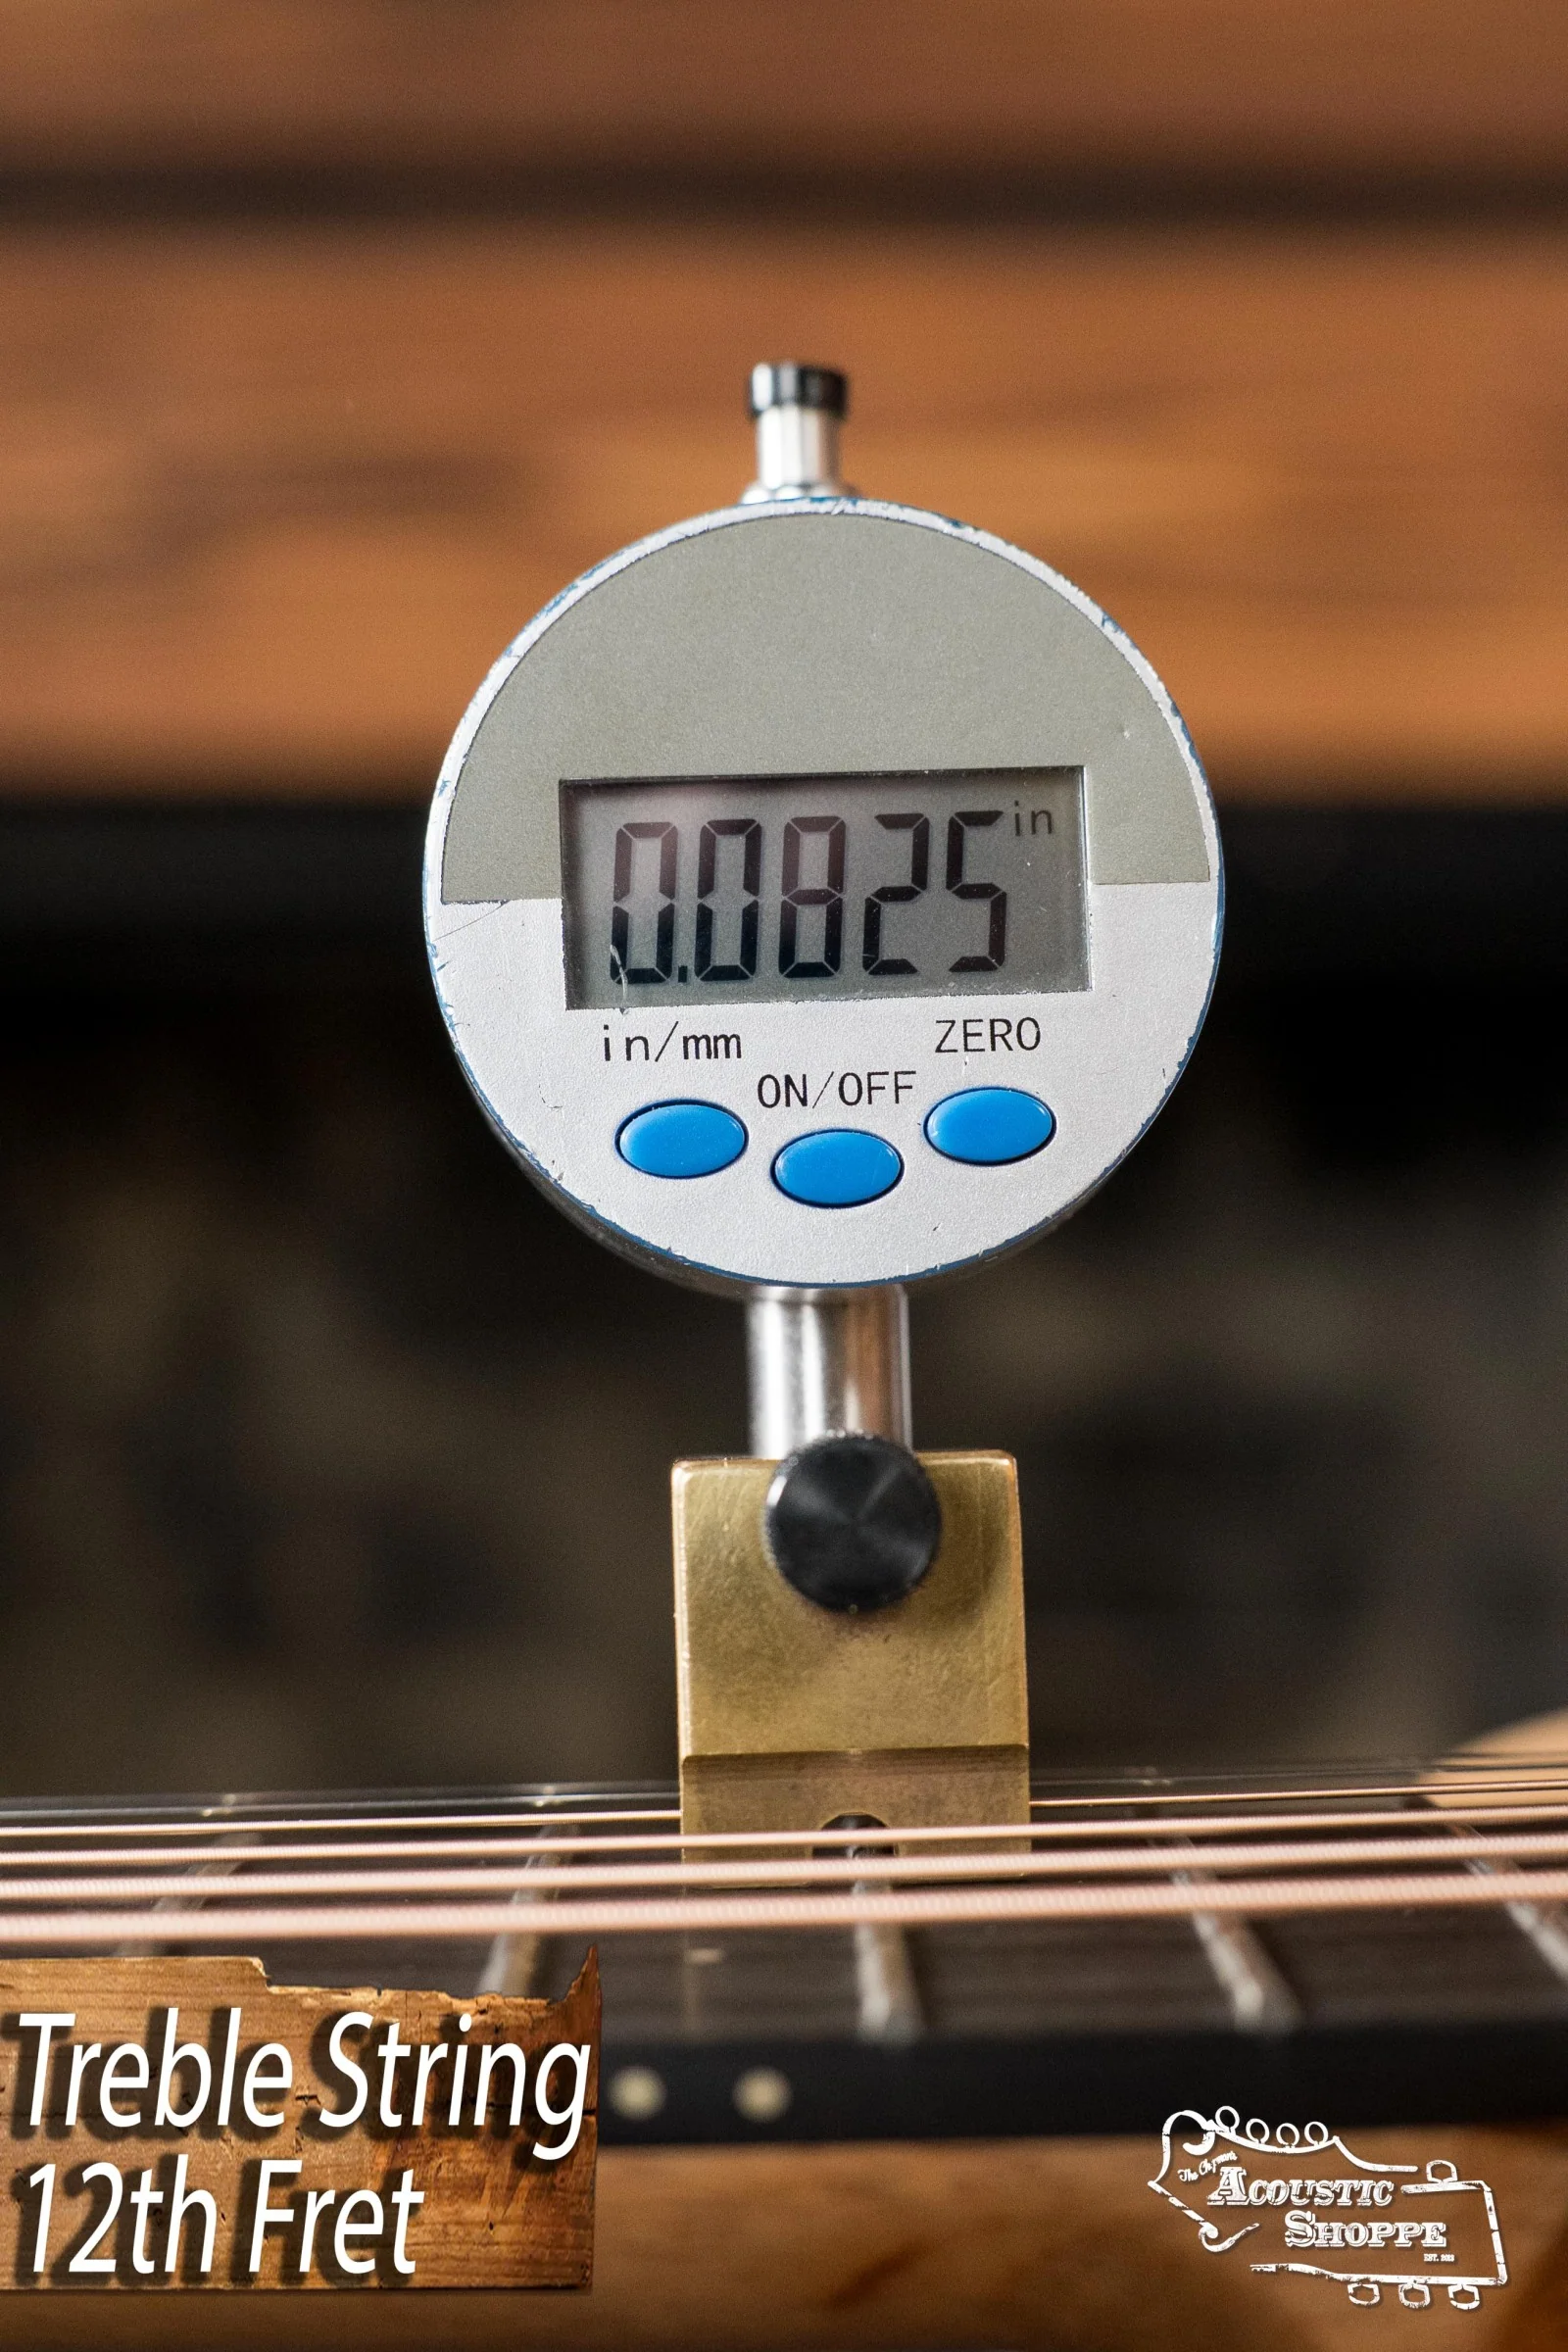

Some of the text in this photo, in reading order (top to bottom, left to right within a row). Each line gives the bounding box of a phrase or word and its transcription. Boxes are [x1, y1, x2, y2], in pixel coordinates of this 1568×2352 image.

[610, 800, 1054, 985] 0.0825 in
[603, 1019, 742, 1062] in/mm
[934, 1016, 1042, 1054] ZERO
[757, 1070, 917, 1109] ON/OFF
